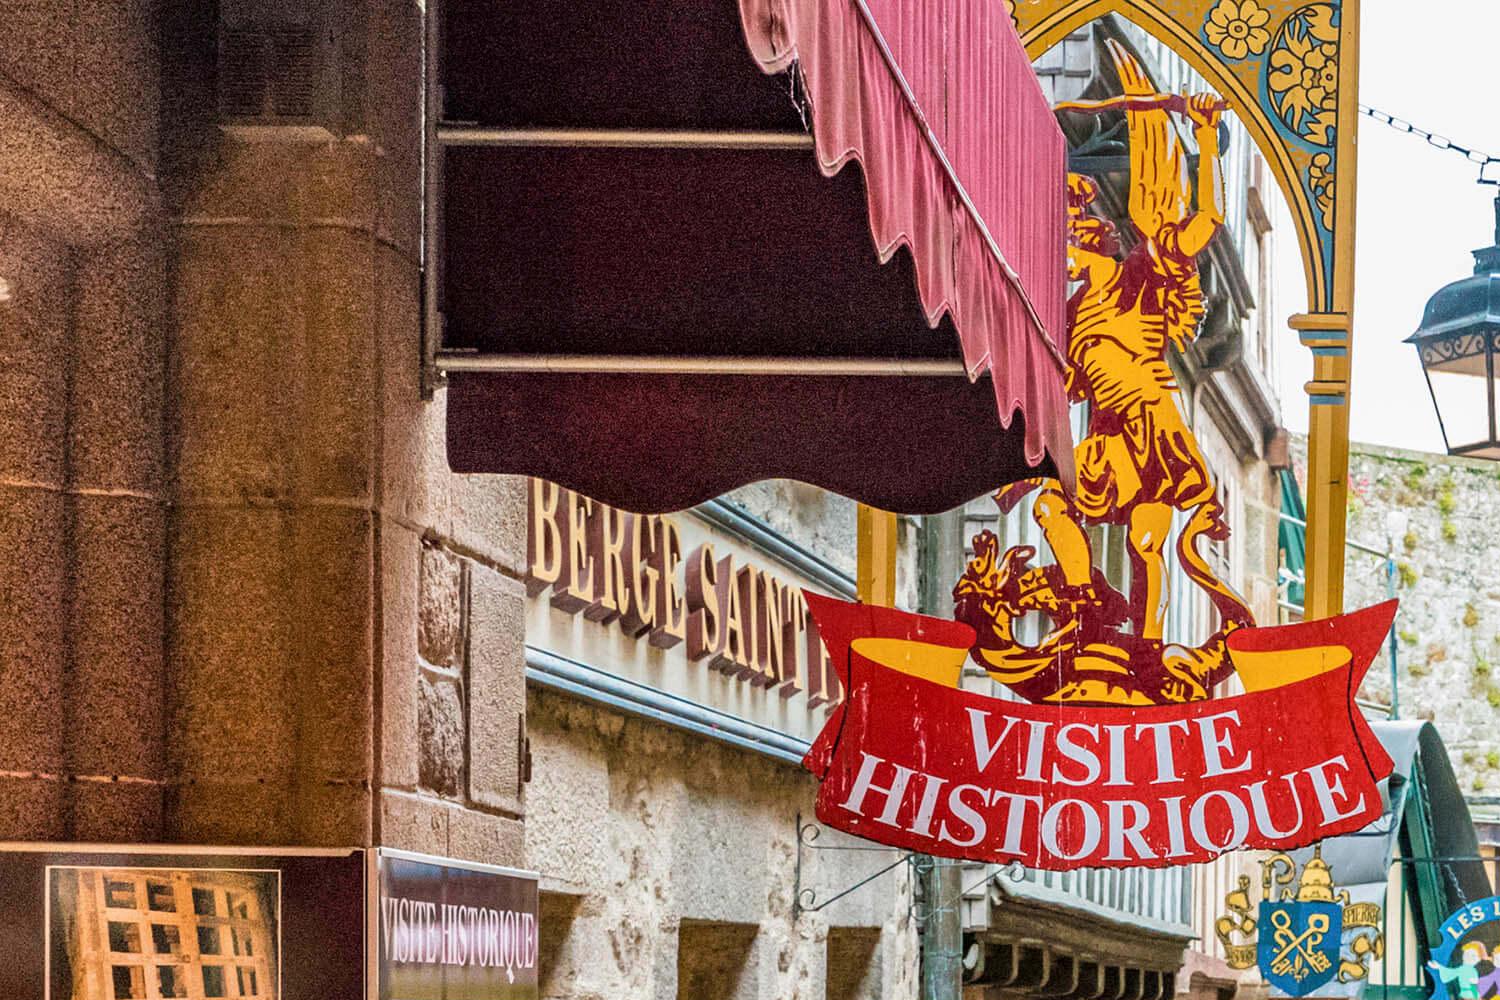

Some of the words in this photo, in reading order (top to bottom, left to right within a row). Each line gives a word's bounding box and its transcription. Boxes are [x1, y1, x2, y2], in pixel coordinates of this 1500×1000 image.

[700, 540, 808, 691] SAINT
[965, 707, 1252, 787] VISITE
[838, 750, 1366, 862] HISTORIQUE
[381, 895, 436, 964] VISITE
[441, 904, 535, 984] HISTORIQUE
[1447, 906, 1486, 940] LES
